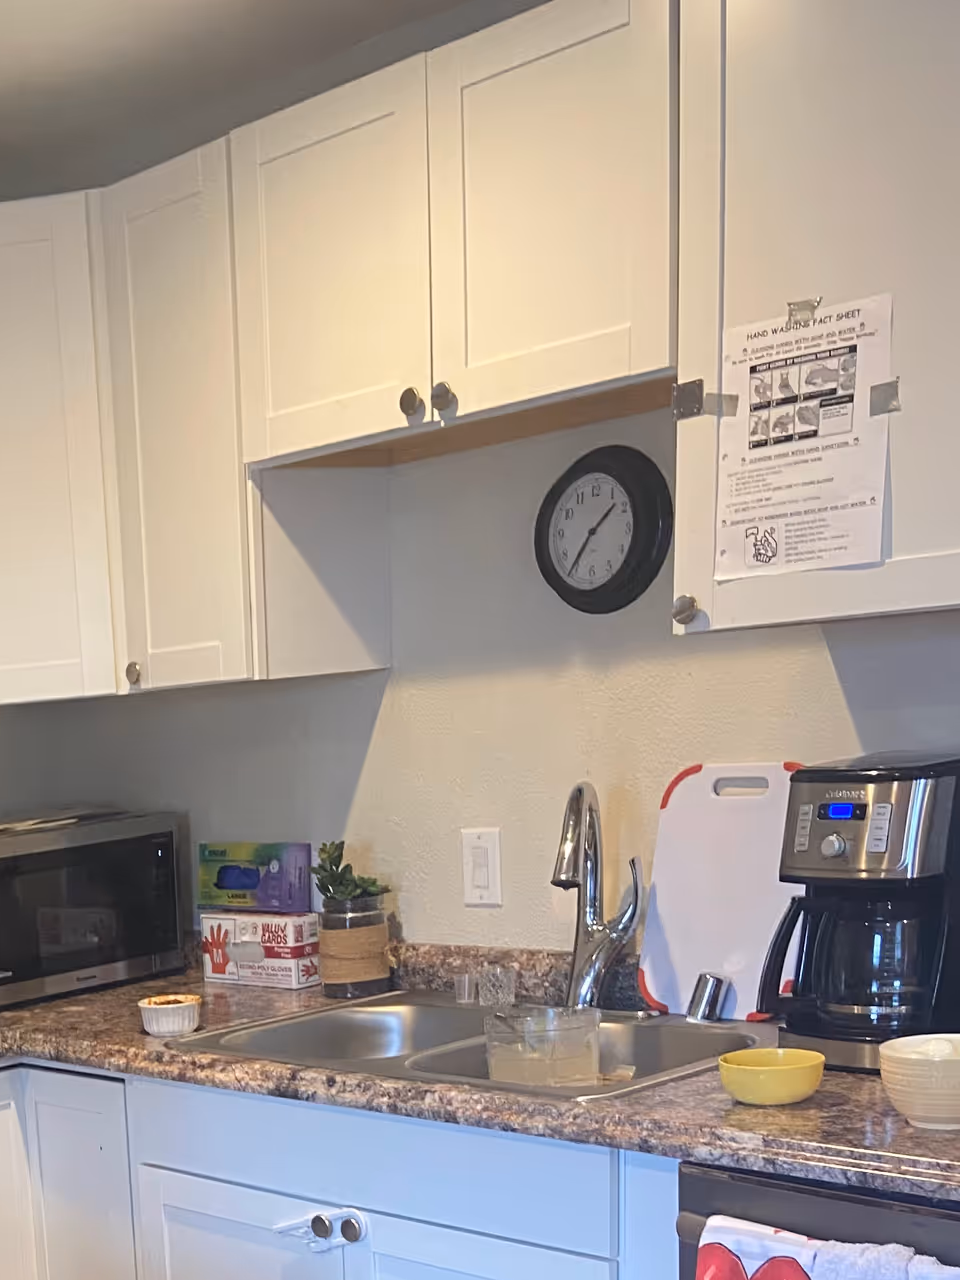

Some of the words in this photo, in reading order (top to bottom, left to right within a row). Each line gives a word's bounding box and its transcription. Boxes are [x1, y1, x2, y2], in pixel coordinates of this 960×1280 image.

[747, 330, 768, 342] HAND
[813, 316, 832, 327] FACT
[836, 309, 861, 321] SHEET
[592, 484, 601, 498] 12
[610, 487, 615, 500] 1
[576, 491, 584, 505] 11
[621, 501, 628, 513] 2
[565, 508, 574, 521] 10
[558, 528, 565, 539] 9
[625, 521, 631, 535] 3
[562, 550, 569, 561] 8
[589, 565, 596, 577] 6
[606, 560, 612, 572] 5
[261, 934, 288, 945] GARDS
[213, 949, 223, 964] M
[271, 966, 293, 974] GLOVES
